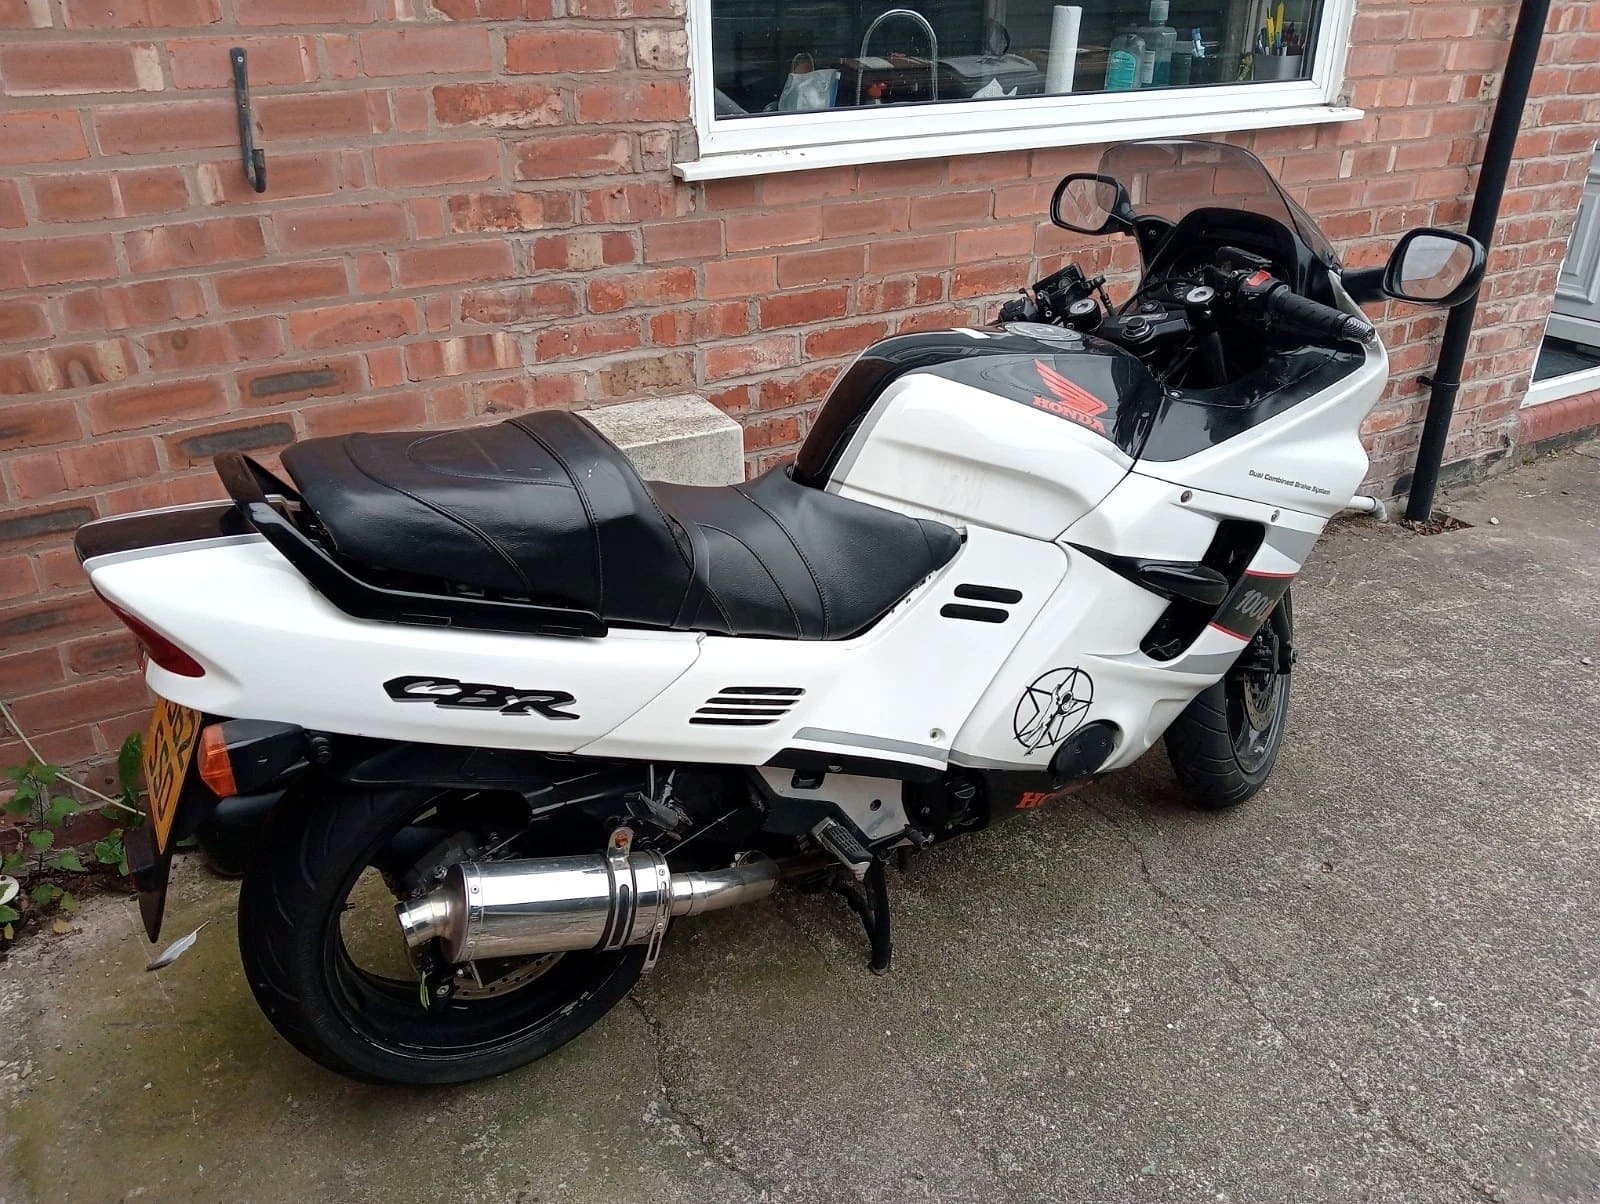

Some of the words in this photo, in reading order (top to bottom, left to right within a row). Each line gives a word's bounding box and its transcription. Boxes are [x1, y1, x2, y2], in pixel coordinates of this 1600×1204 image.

[1032, 396, 1107, 434] HONDA
[1248, 469, 1264, 479] Dual
[1264, 473, 1295, 487] Combined
[1294, 481, 1312, 491] Brake
[1311, 486, 1331, 495] System
[383, 675, 581, 720] CBR
